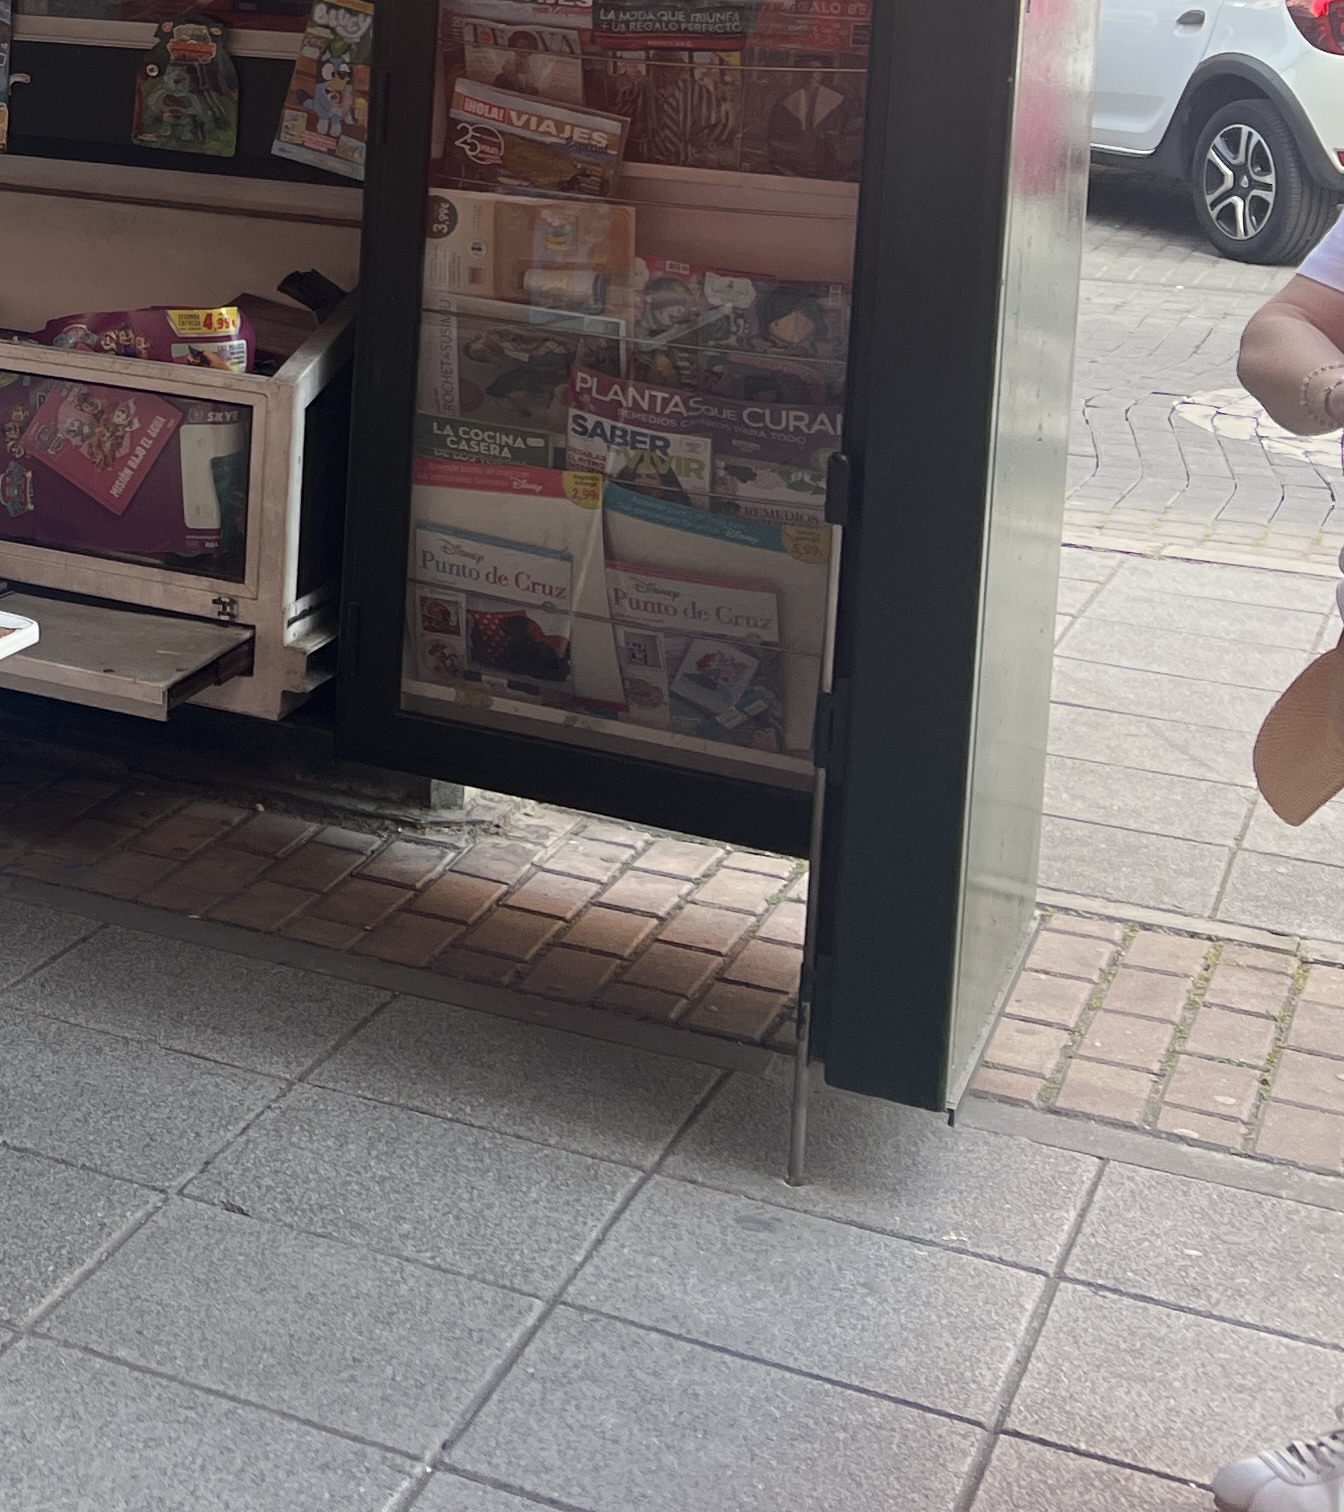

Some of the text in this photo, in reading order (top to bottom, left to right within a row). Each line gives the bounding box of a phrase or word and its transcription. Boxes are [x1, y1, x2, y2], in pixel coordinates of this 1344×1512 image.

[508, 110, 610, 148] VIAJES
[574, 370, 703, 418] PLANTAS
[703, 403, 739, 422] QUE
[148, 414, 170, 441] AGUA
[432, 421, 527, 449] LA COCINA
[445, 437, 513, 459] CASERA
[571, 413, 671, 457] SABER
[420, 548, 568, 600] Punto de Cruz
[612, 586, 774, 631] Punto de Cruz
